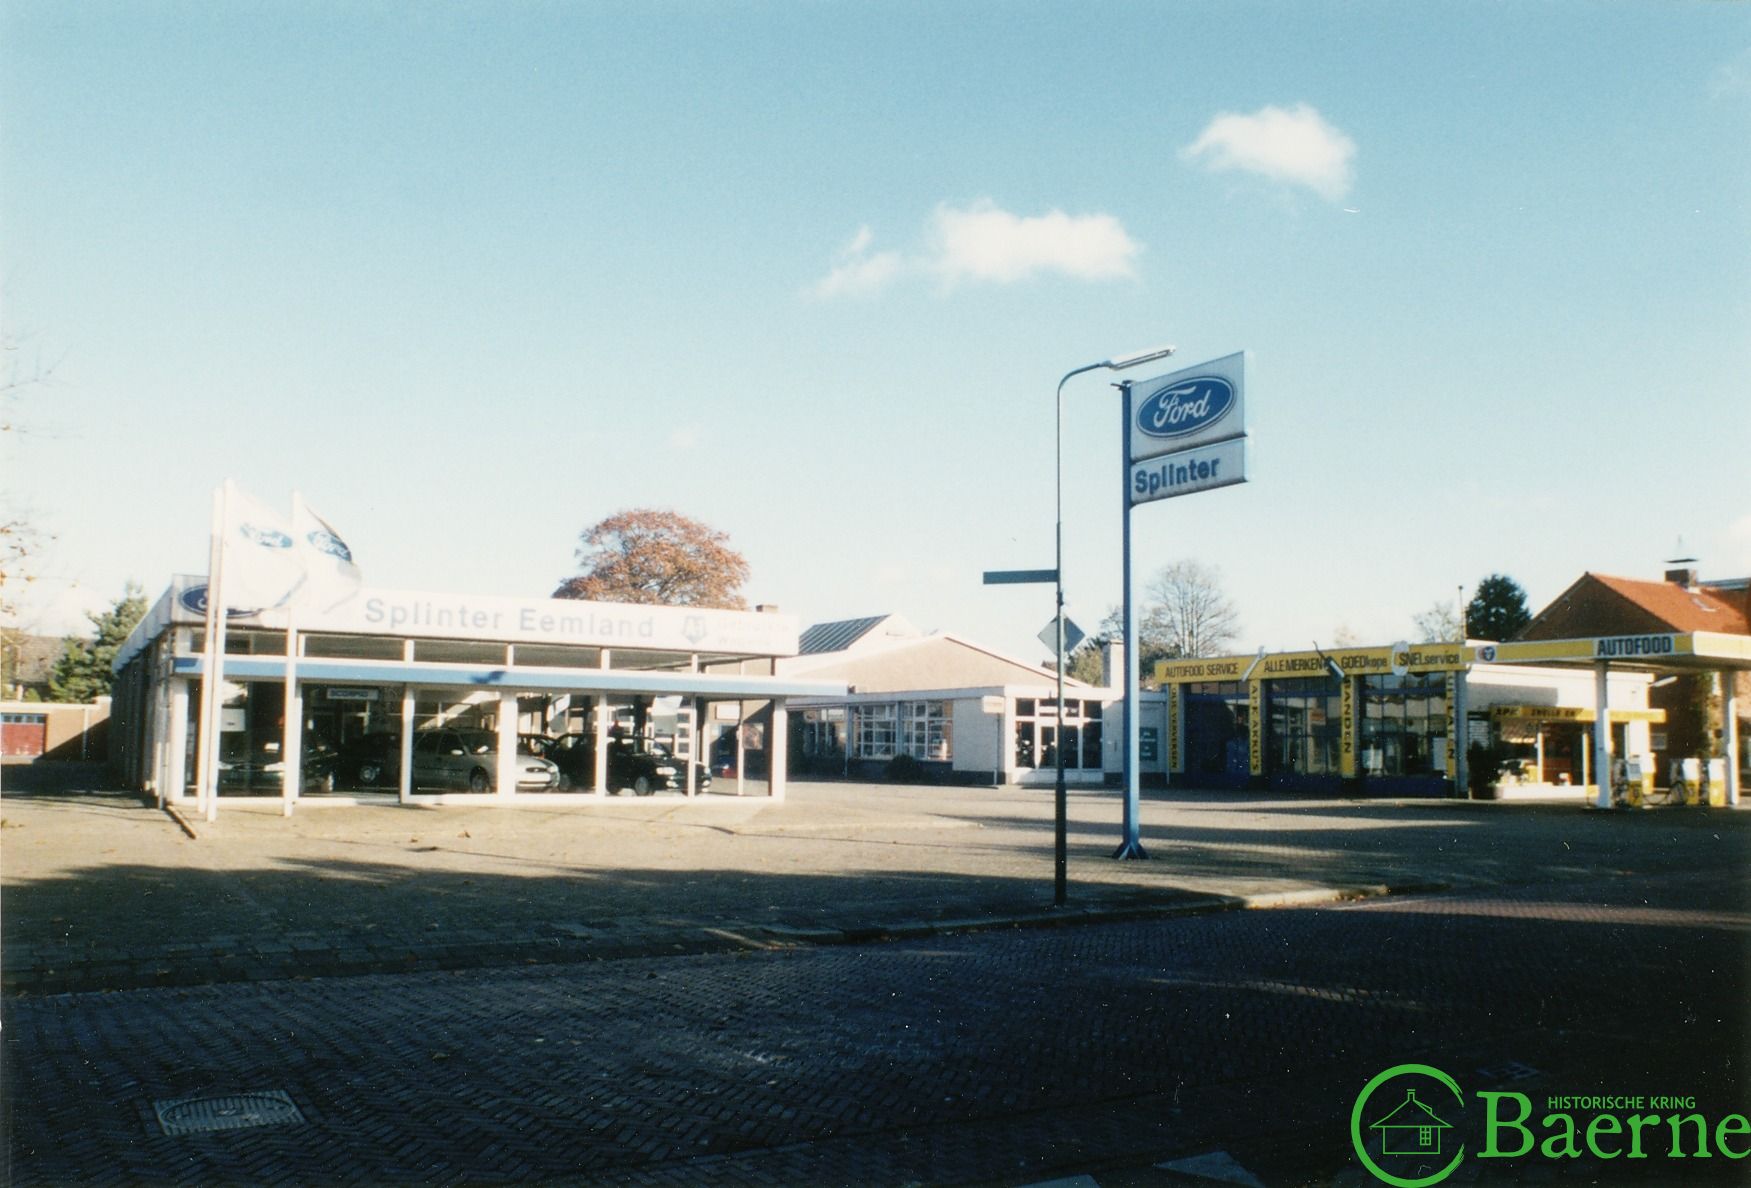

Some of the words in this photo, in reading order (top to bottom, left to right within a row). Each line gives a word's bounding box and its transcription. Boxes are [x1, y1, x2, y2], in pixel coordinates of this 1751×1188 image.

[1153, 385, 1212, 428] Ford
[1135, 458, 1219, 494] Splinter
[365, 598, 503, 629] Splinter
[519, 608, 655, 638] Eemland
[1597, 636, 1673, 656] AUTOFOOD
[1263, 659, 1285, 673] ALLE
[1286, 657, 1322, 672] MERKEN
[1398, 649, 1460, 666] SNELservice
[1165, 665, 1204, 678] AUTOFOOD
[1206, 662, 1239, 676] SERVICE
